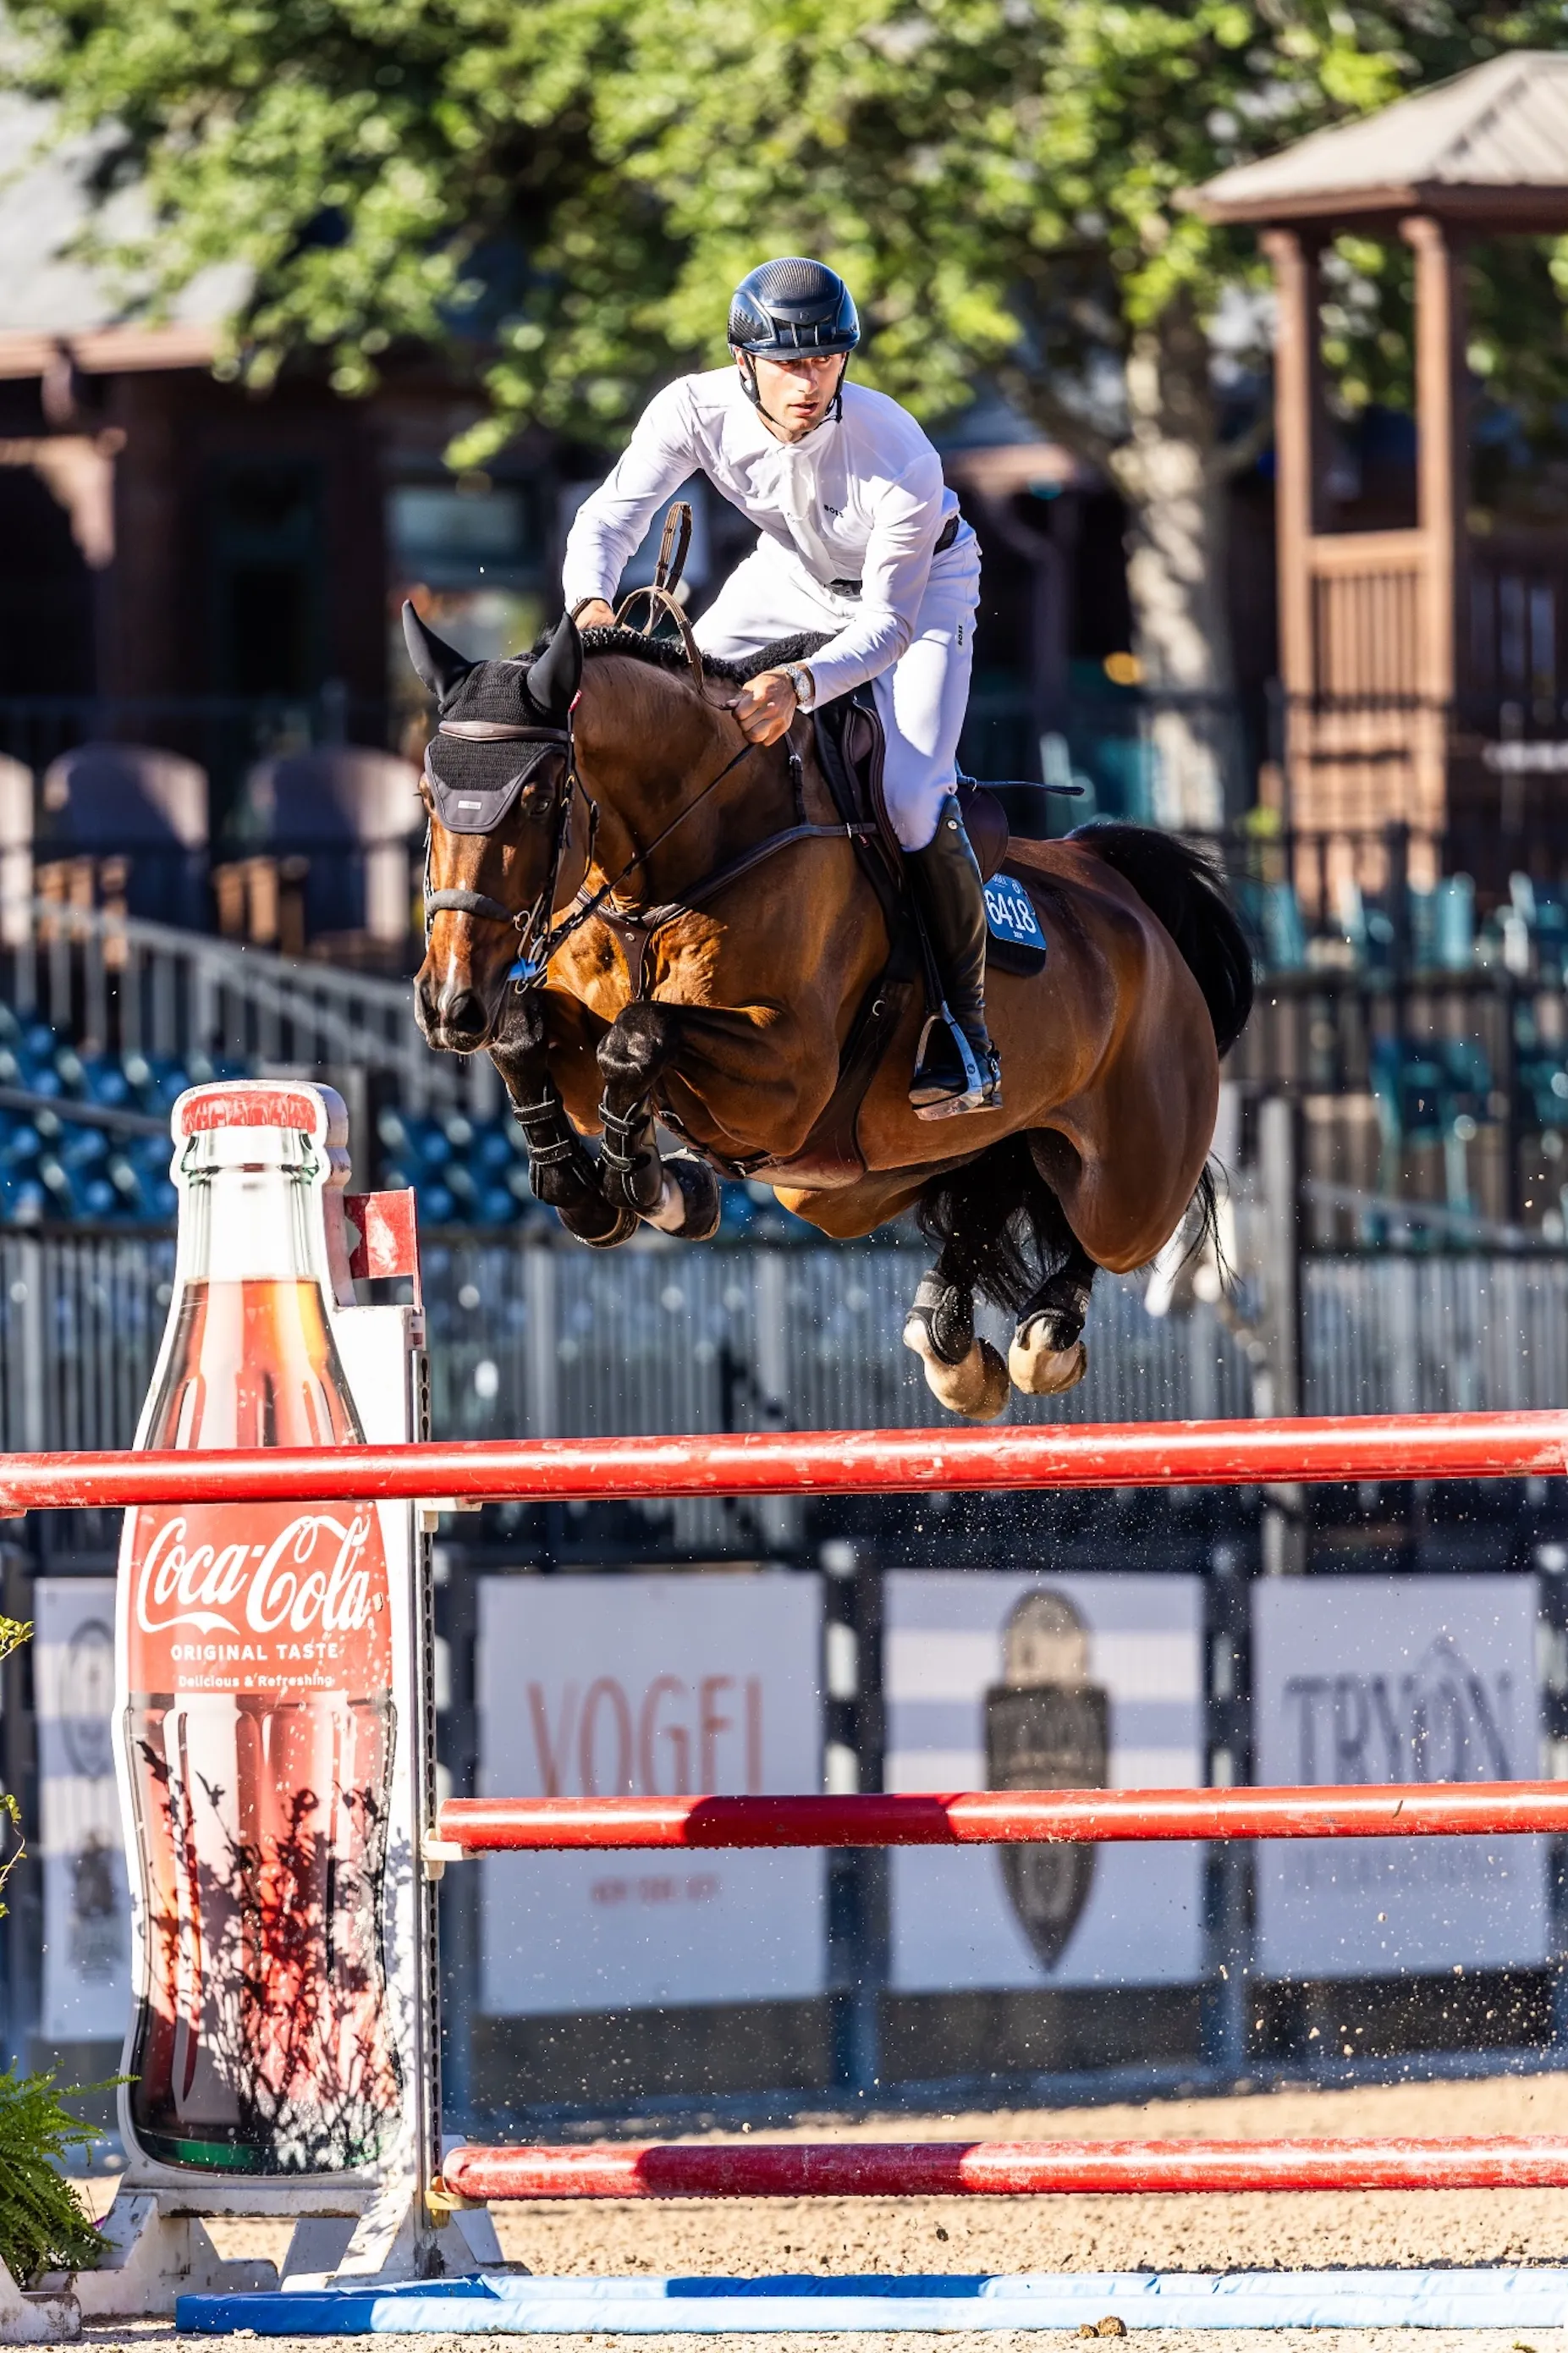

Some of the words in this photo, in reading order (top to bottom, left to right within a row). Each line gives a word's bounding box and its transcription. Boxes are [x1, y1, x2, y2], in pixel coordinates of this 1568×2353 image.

[983, 889, 1036, 934] 6418
[137, 1515, 371, 1635] Coca-Cola
[171, 1644, 268, 1661] ORIGINAL
[276, 1642, 338, 1660] TASTE
[178, 1675, 239, 1688] Delicious
[244, 1676, 254, 1688] &
[258, 1673, 335, 1689] Refreshing
